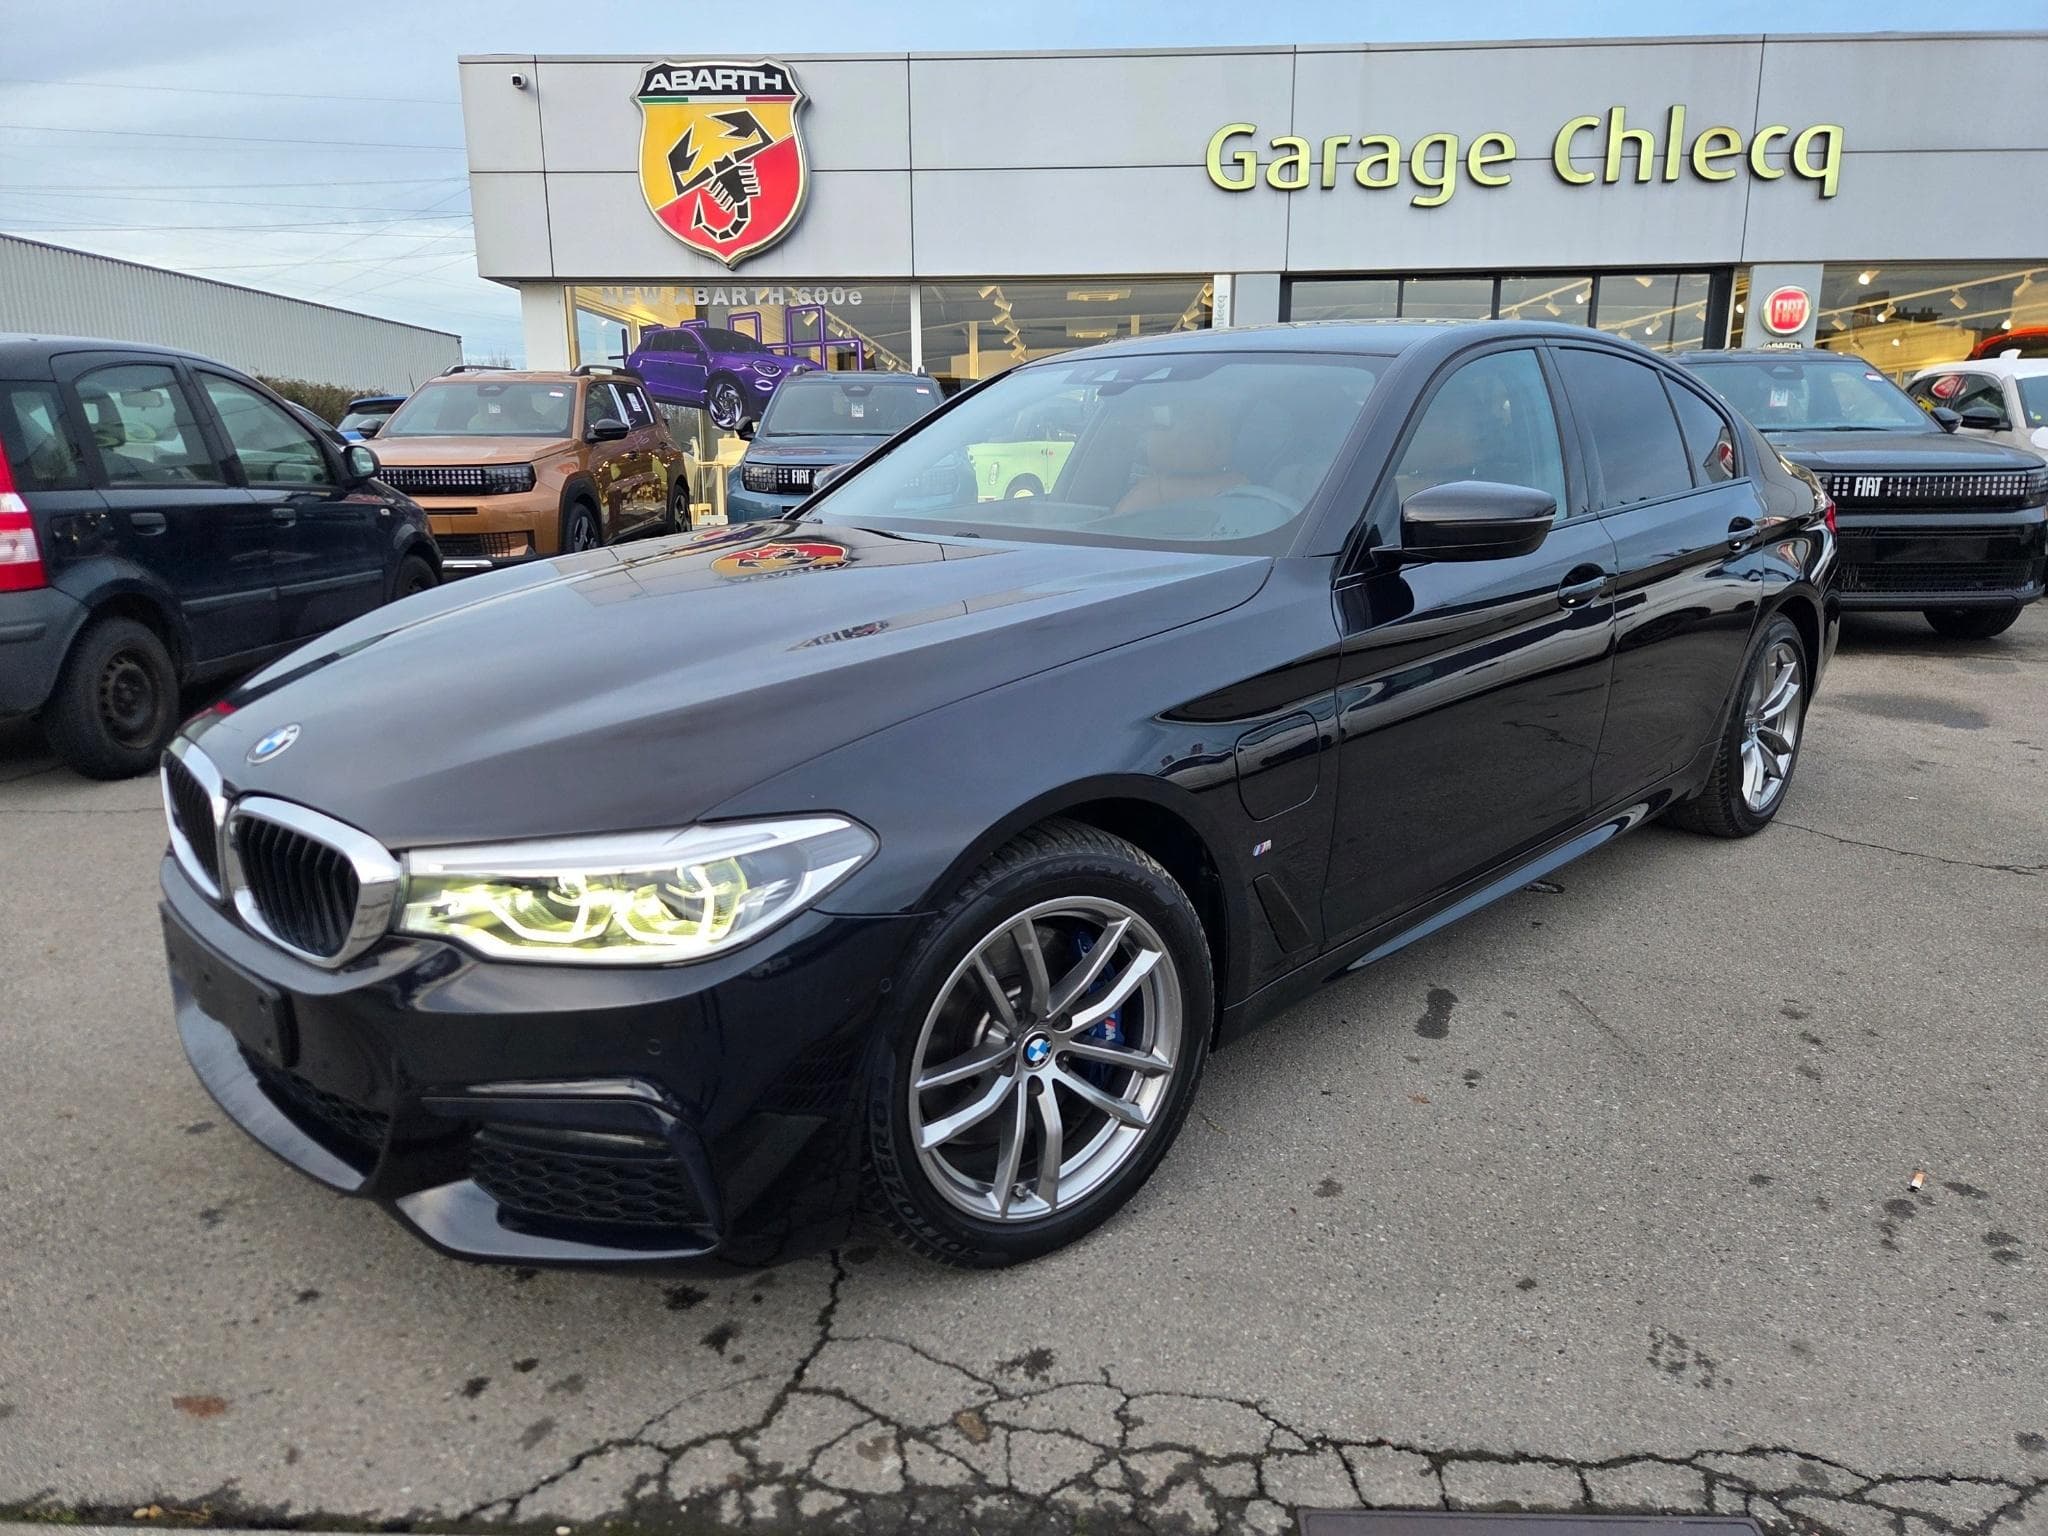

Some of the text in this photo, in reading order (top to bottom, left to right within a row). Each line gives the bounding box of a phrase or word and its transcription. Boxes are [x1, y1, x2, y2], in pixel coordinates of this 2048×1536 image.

[647, 68, 783, 92] ABARTH
[1205, 104, 1845, 208] Garage Chlecq
[602, 286, 863, 305] NEW ABARTH 600e
[791, 469, 811, 484] FIAT
[1853, 476, 1884, 497] FIAT
